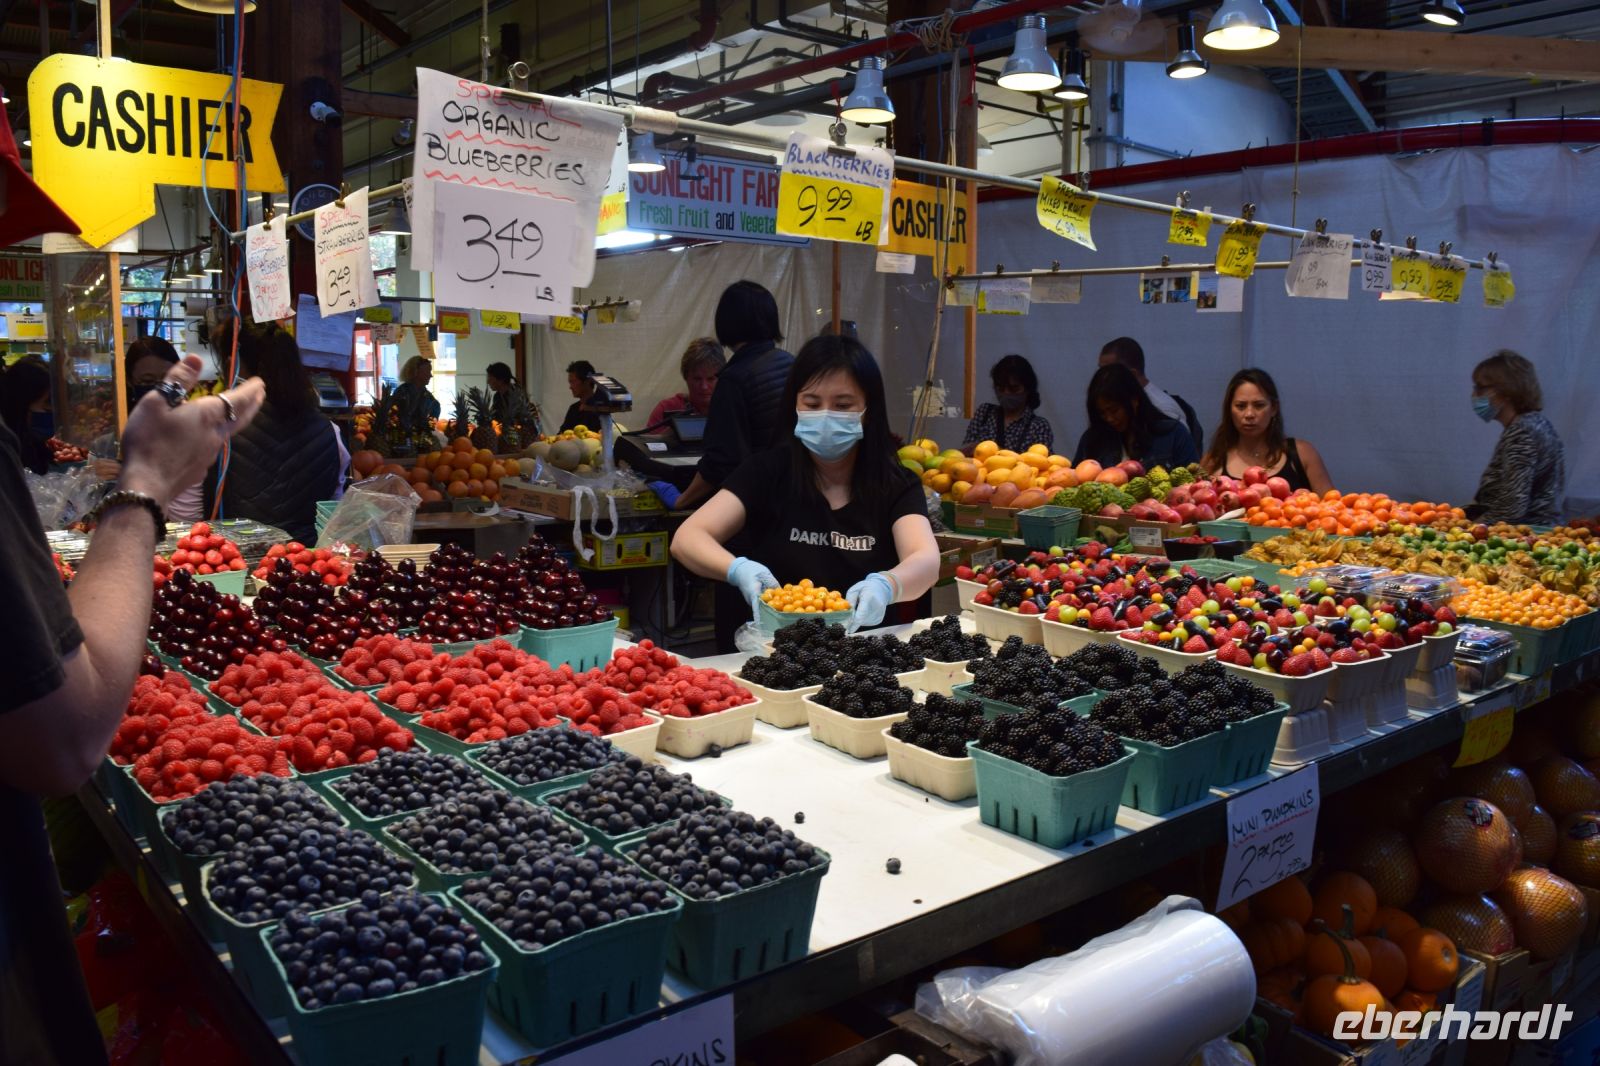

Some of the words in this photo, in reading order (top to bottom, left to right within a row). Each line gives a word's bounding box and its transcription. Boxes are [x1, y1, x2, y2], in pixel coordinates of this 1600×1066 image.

[52, 82, 254, 163] CASHIER
[442, 100, 561, 142] ORGANIC
[424, 132, 586, 185] BLUEBERRIES
[786, 143, 890, 180] BLACKBERRIES
[633, 158, 735, 204] SUNLIGHT
[639, 201, 673, 225] Fresh
[678, 204, 710, 229] Fruit
[715, 211, 735, 231] and
[789, 527, 830, 546] DARK
